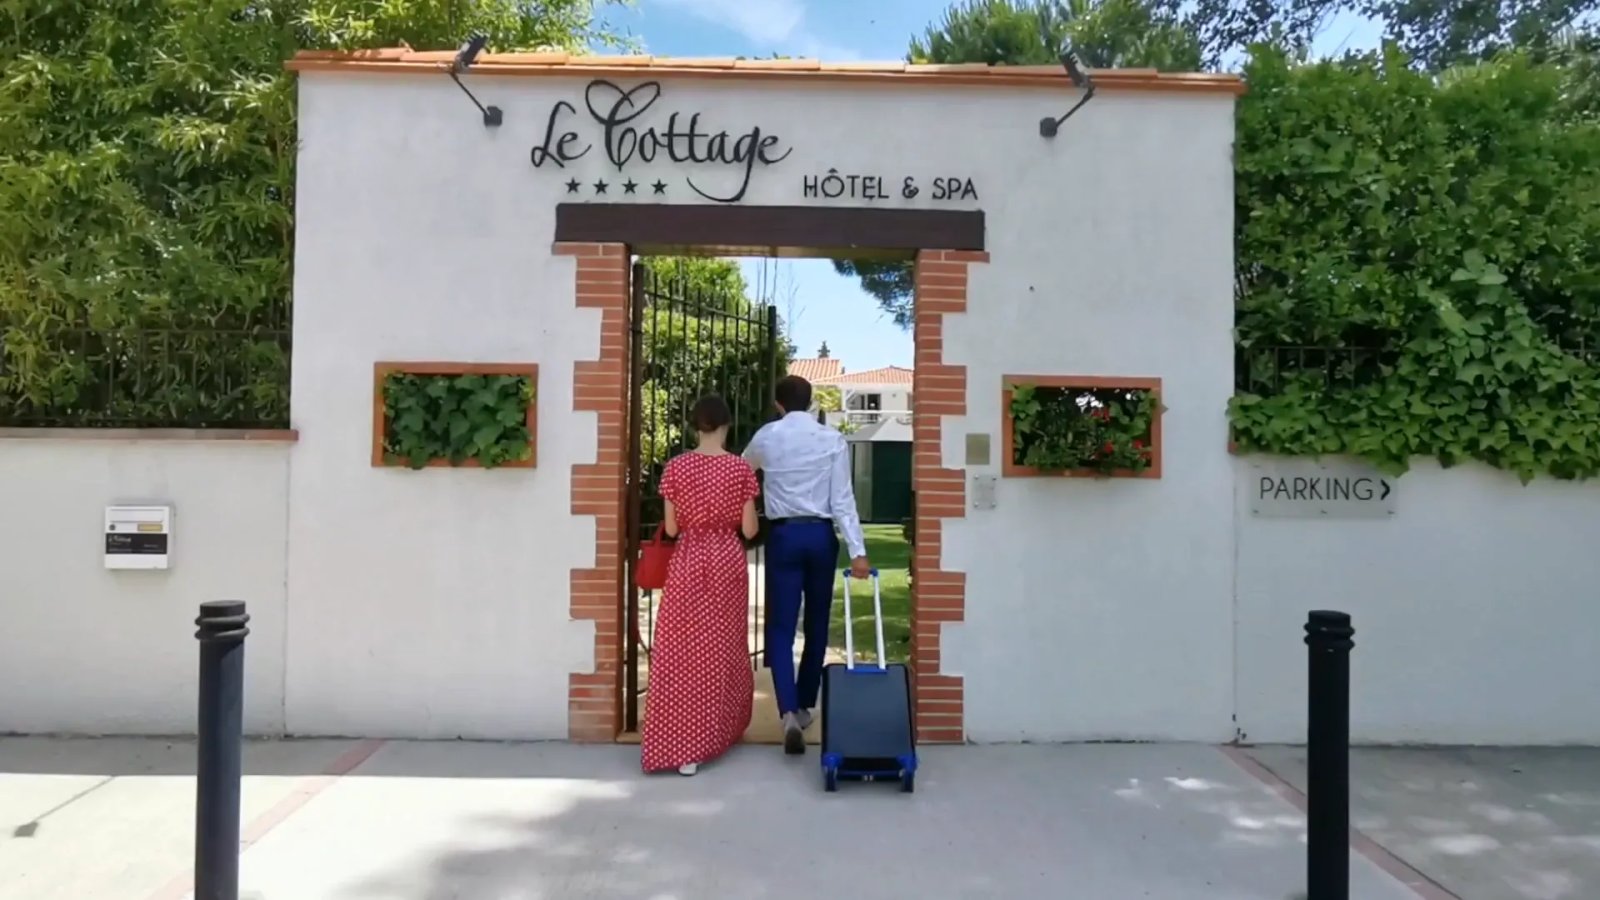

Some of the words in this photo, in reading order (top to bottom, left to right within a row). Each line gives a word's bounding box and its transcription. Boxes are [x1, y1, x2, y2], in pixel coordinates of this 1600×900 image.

[531, 101, 592, 168] Le
[585, 79, 793, 202] Cottage
[803, 168, 889, 199] HÔTEL
[902, 177, 919, 197] &
[932, 177, 978, 199] SPA
[1260, 477, 1373, 500] PARKING
